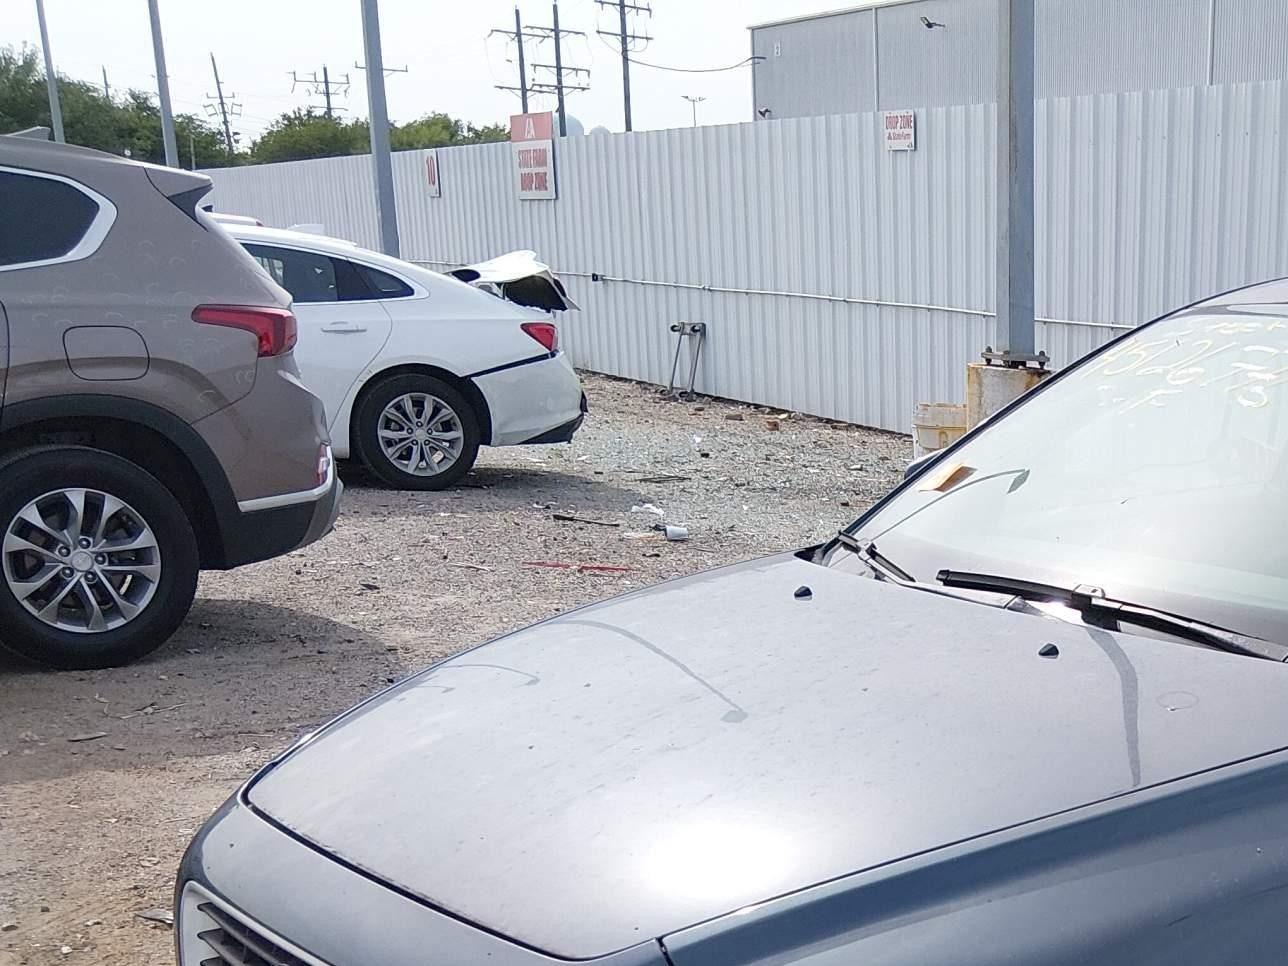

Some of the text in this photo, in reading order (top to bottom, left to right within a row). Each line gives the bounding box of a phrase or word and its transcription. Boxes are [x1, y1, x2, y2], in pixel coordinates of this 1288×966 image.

[885, 114, 912, 129] DROP ZONE
[426, 155, 436, 185] 10
[520, 171, 548, 192] DROP ZONE
